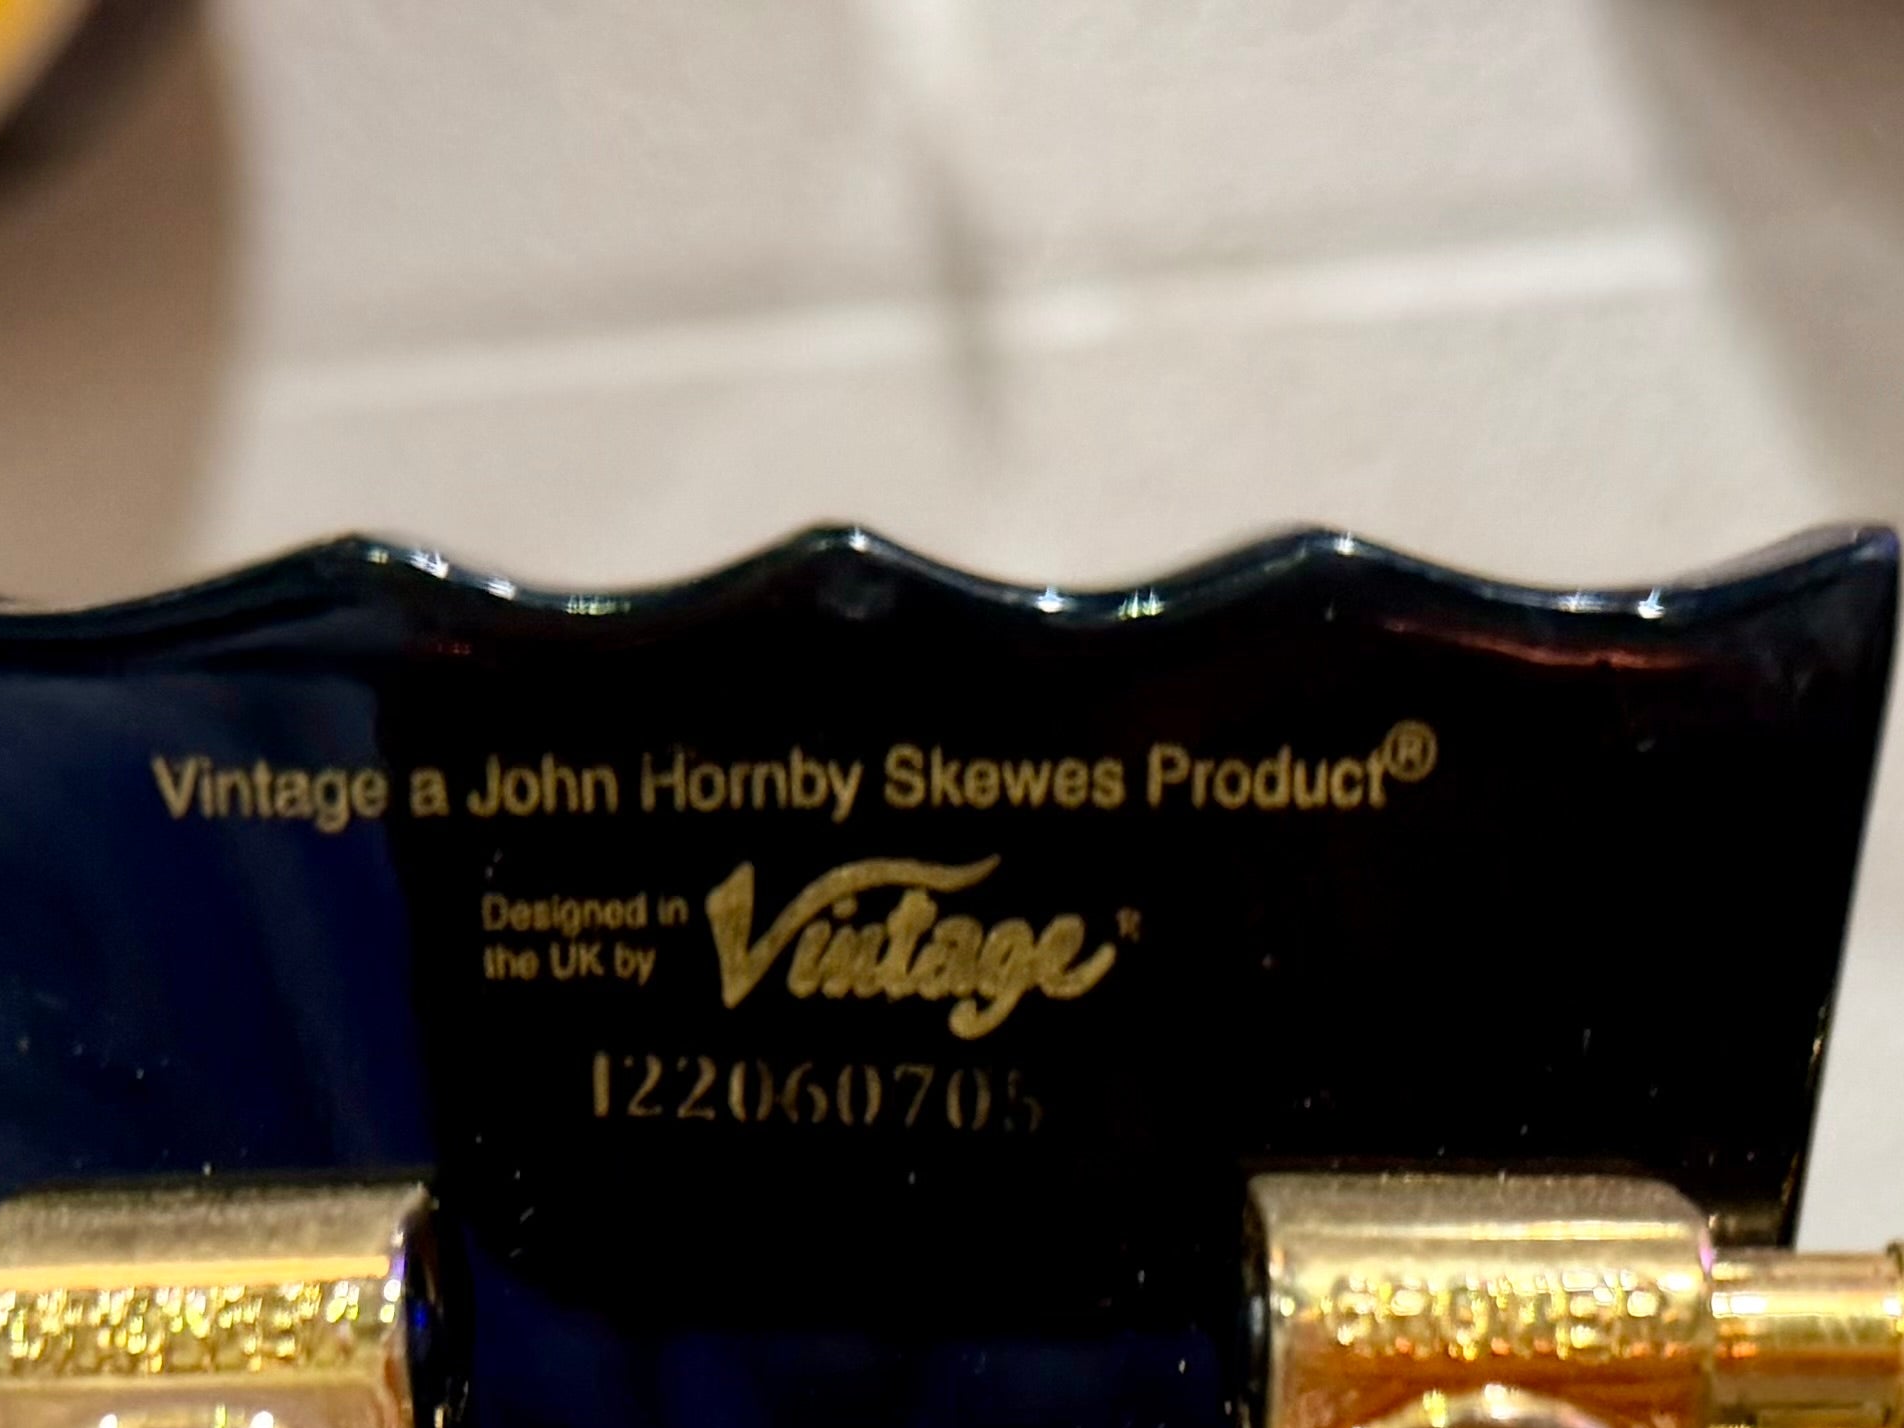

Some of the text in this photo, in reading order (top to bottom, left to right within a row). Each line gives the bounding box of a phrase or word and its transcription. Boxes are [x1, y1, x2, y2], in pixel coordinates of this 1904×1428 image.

[152, 753, 389, 832] Vintage
[409, 769, 449, 817] a
[468, 756, 621, 816] John
[639, 750, 863, 822] Hornby
[882, 745, 1127, 809] Skewes
[481, 891, 690, 939] Designed in
[482, 941, 656, 988] the UK by
